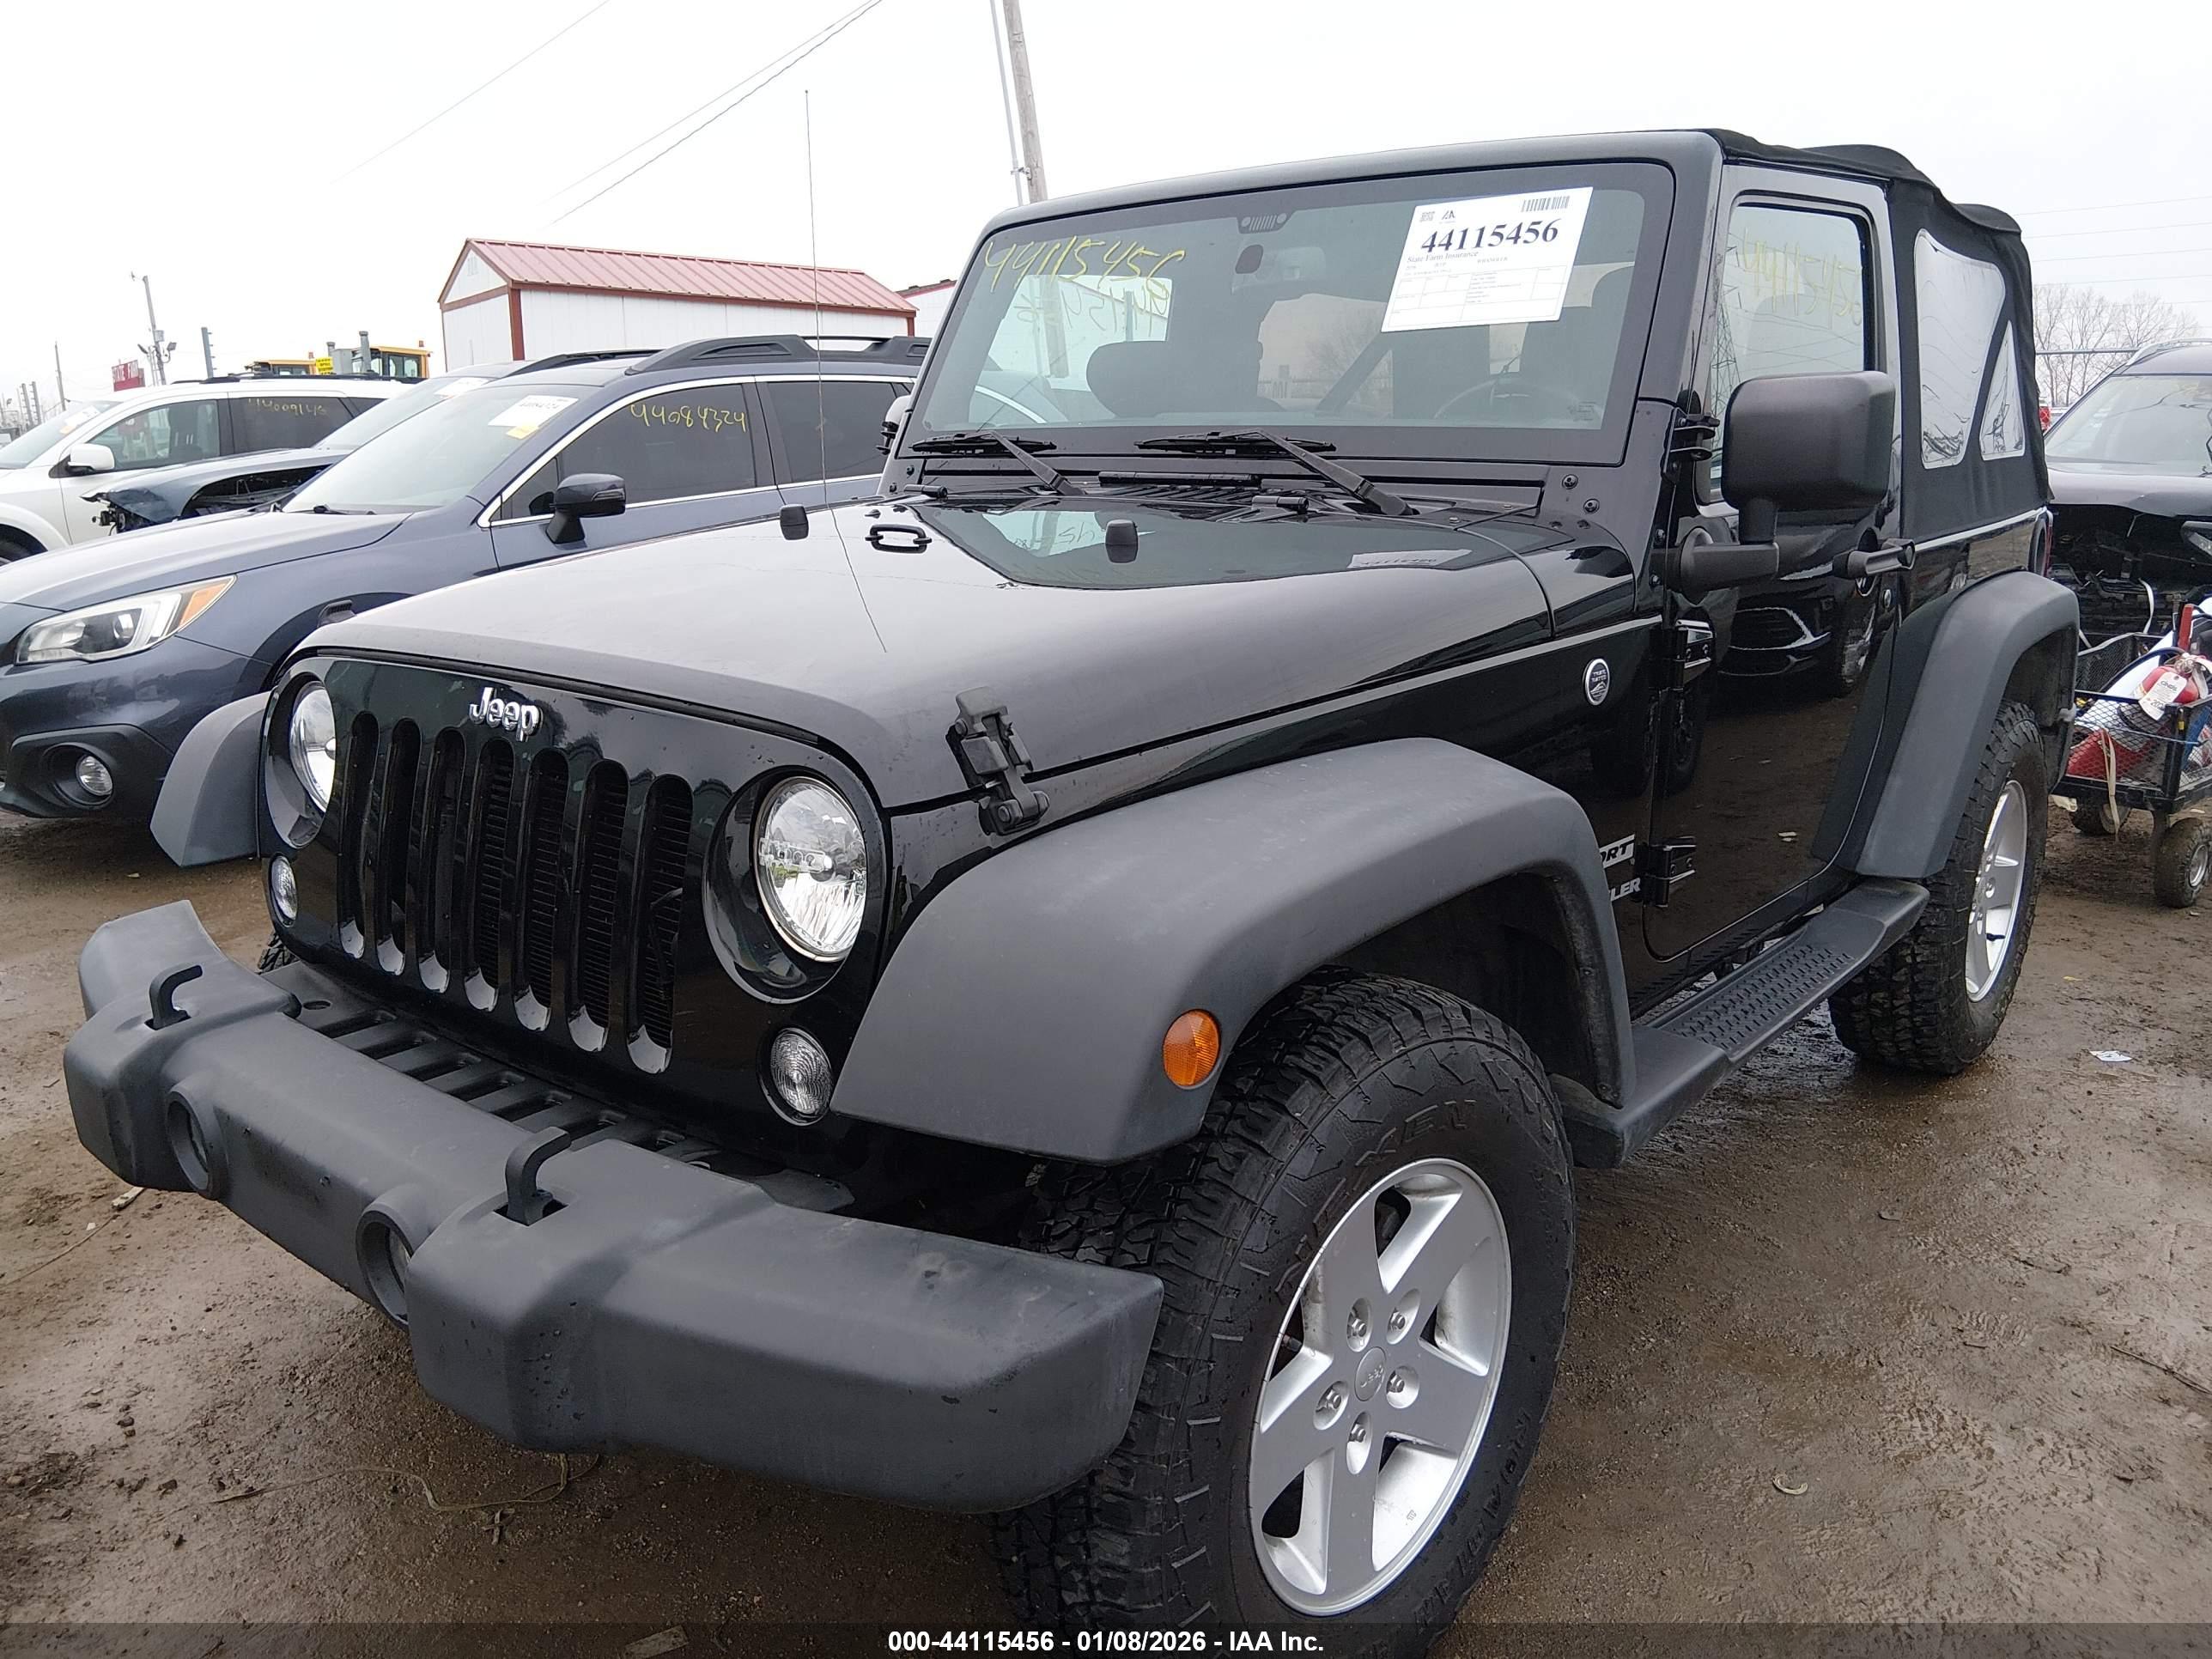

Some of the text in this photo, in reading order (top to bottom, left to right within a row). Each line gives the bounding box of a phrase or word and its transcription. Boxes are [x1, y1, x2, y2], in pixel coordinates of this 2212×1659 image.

[1421, 218, 1562, 252] 44115456
[985, 235, 1186, 300] 44115456
[1425, 253, 1443, 262] Farm
[630, 404, 747, 433] 44084324
[469, 686, 543, 742] Jeep
